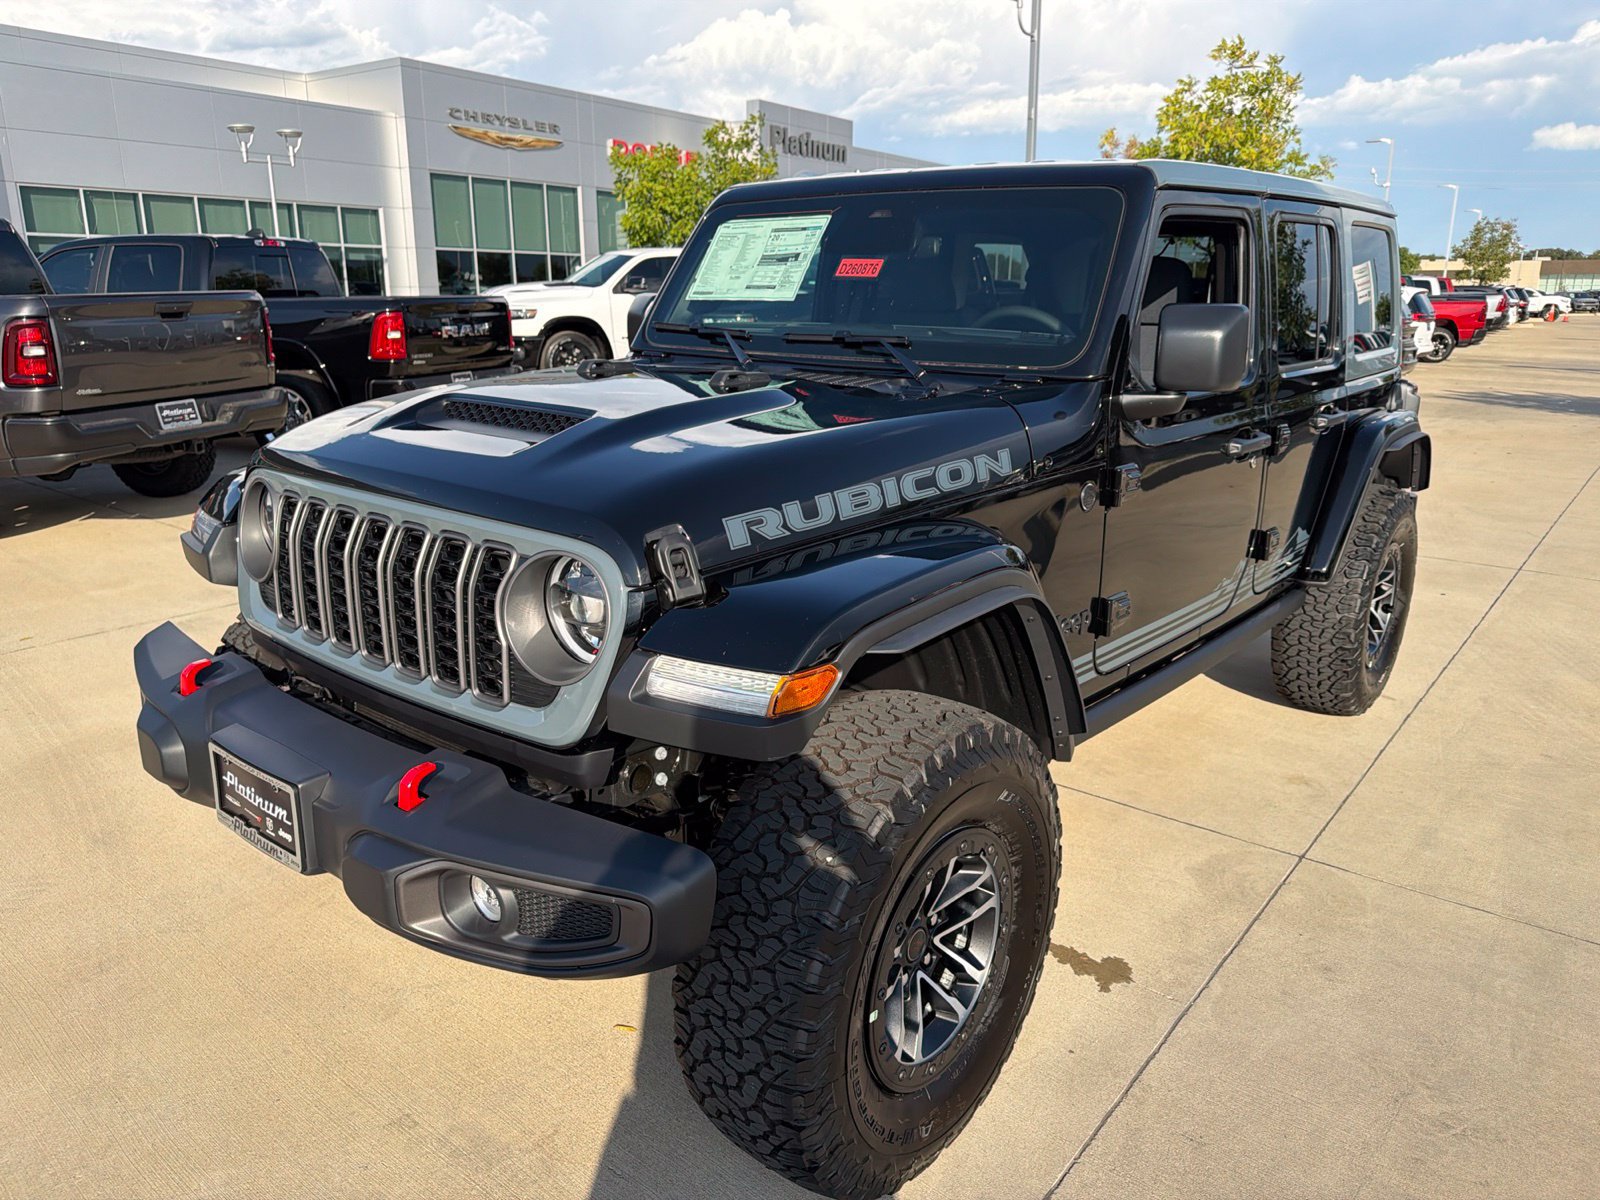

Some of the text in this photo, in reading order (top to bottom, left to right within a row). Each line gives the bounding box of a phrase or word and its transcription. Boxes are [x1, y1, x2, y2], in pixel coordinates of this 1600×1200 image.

[448, 107, 560, 135] CHRYSLER
[768, 124, 848, 164] Platinum
[838, 263, 879, 275] D260876
[721, 448, 1015, 551] RUBICON
[222, 771, 292, 826] Platinum
[231, 817, 284, 861] Platinum
